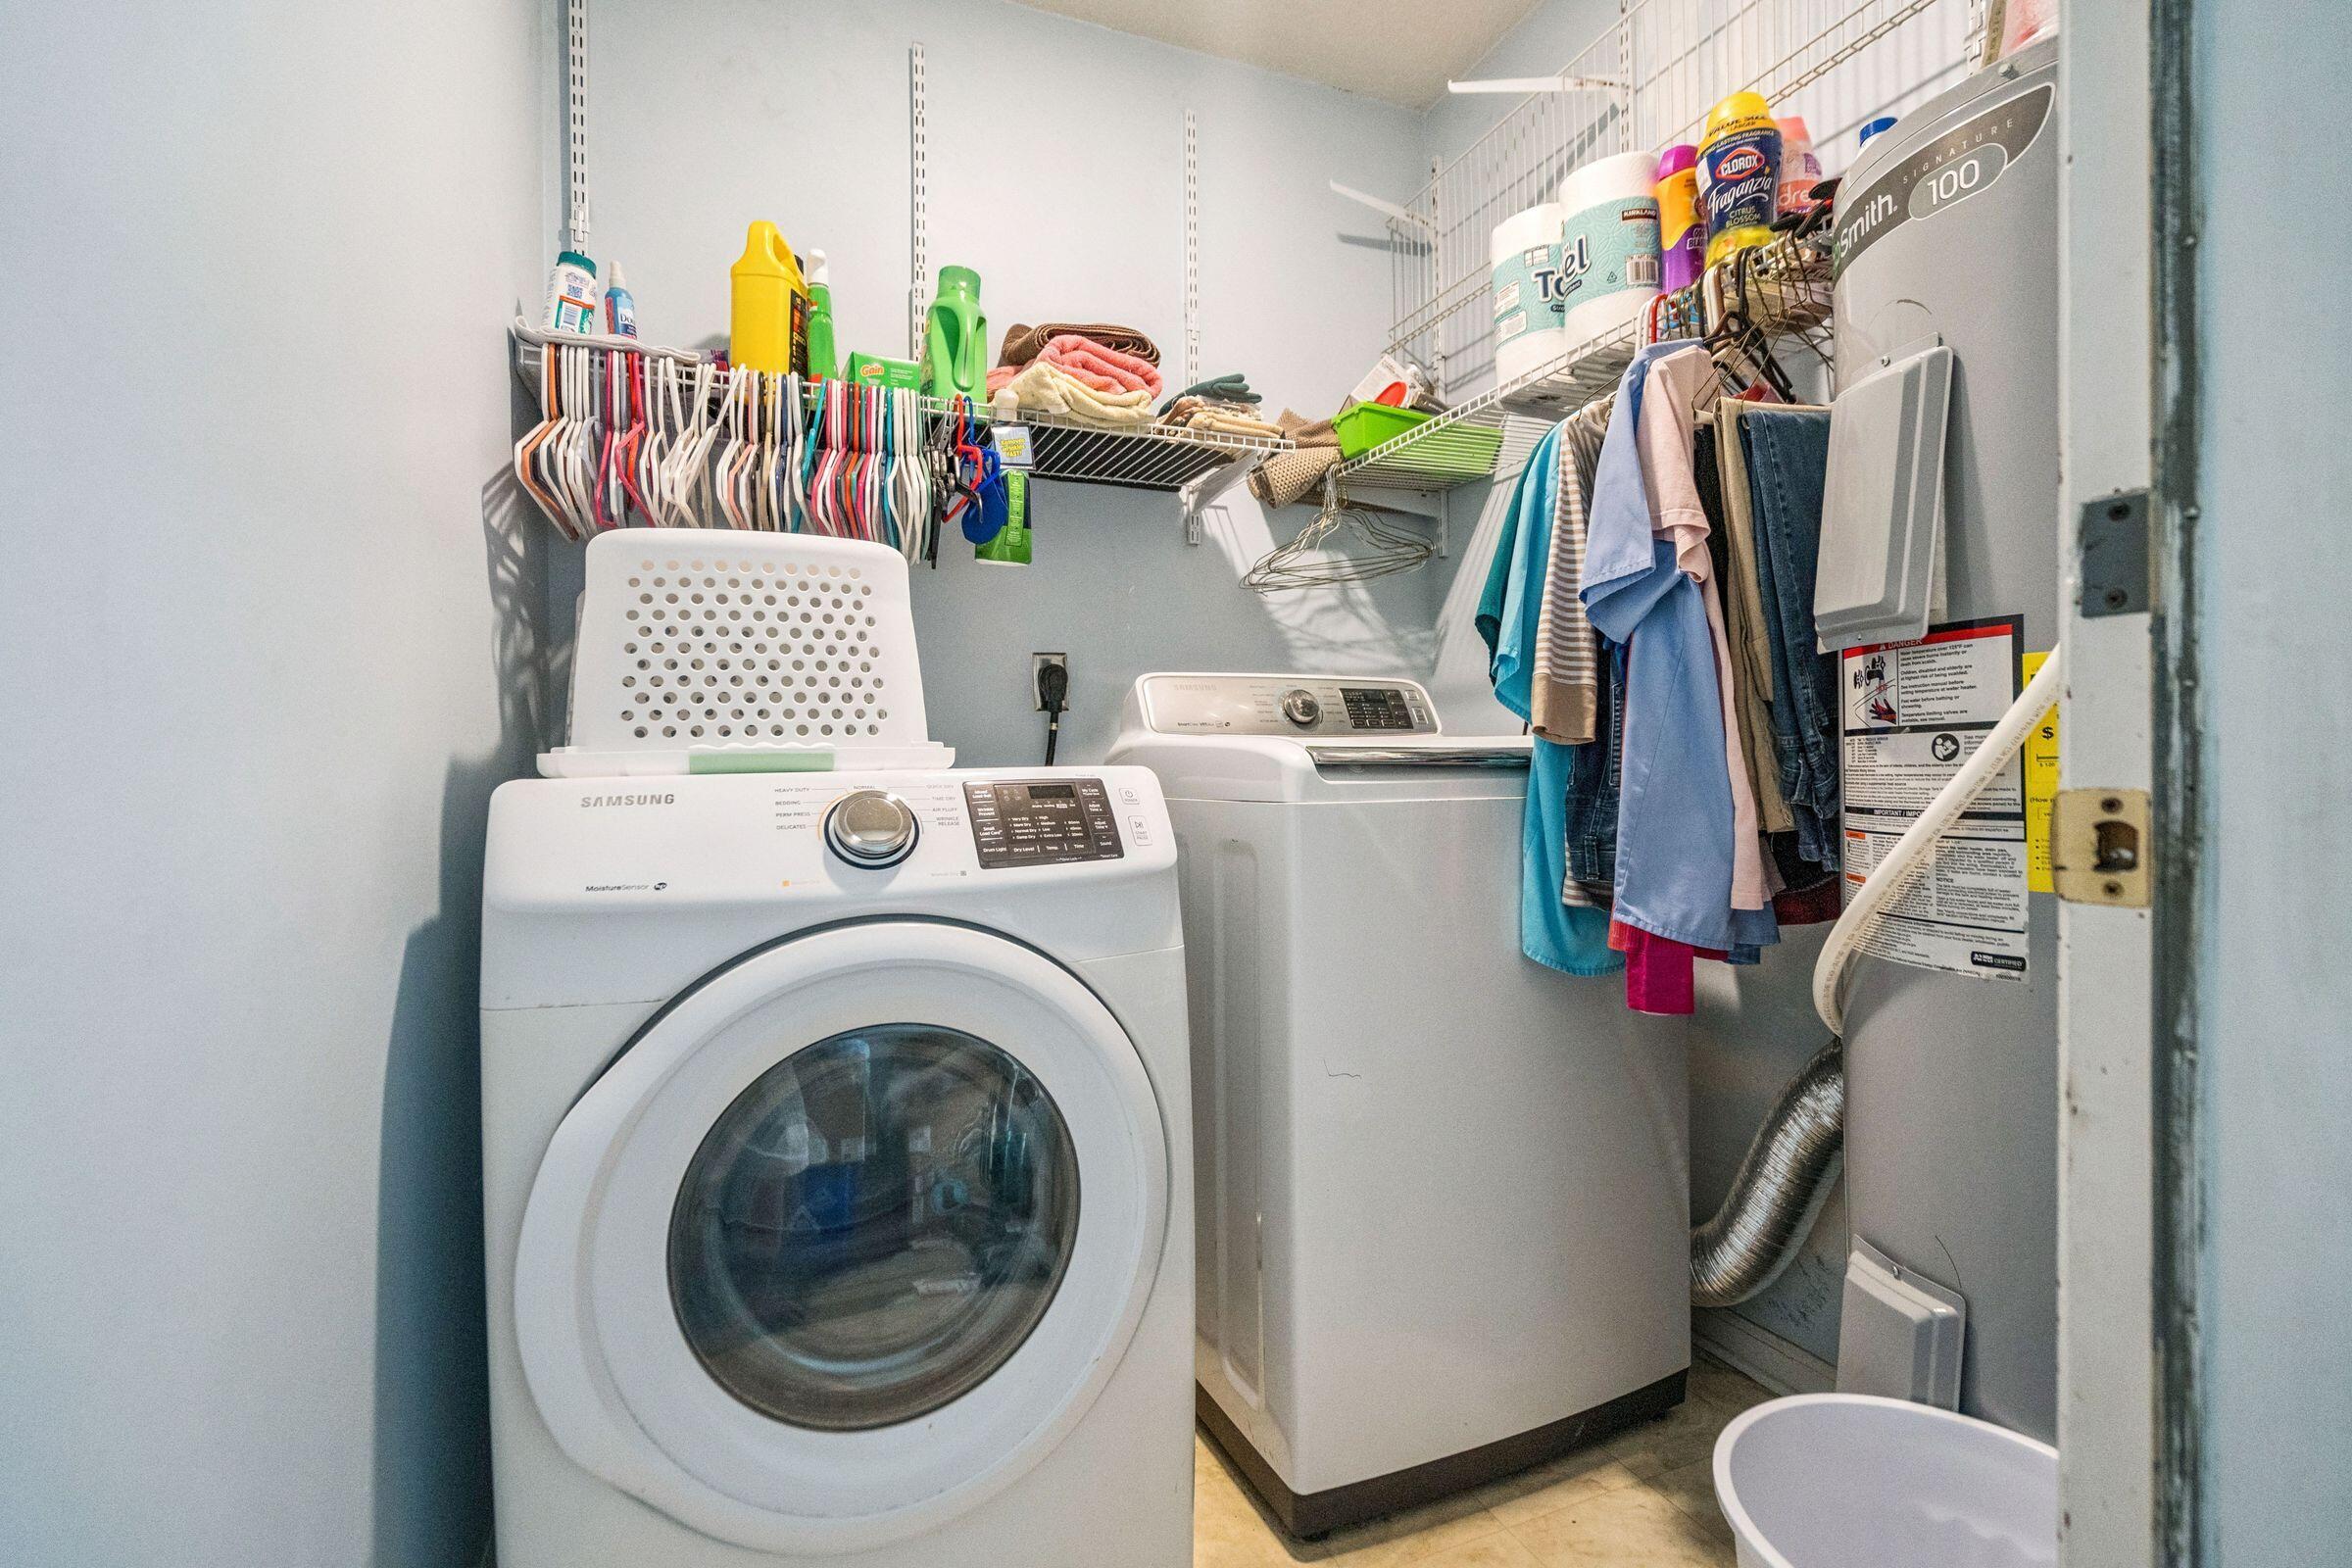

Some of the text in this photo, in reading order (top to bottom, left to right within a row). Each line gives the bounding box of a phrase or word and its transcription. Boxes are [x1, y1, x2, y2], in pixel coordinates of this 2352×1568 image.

[1903, 119, 2014, 184] SIGNATURE
[1721, 155, 1759, 176] CLOROX
[1928, 159, 1981, 207] 100
[1624, 209, 1657, 218] KIRKLAND
[1729, 205, 1756, 218] CITRUS
[1725, 214, 1761, 228] BLOSSOM
[860, 364, 886, 378] Gain
[1887, 639, 1923, 650] DANGER
[2041, 726, 2054, 740] $
[580, 793, 675, 808] SAMSUNG
[1874, 808, 1902, 817] IMPORTANT
[585, 883, 650, 893] MoistureSensor
